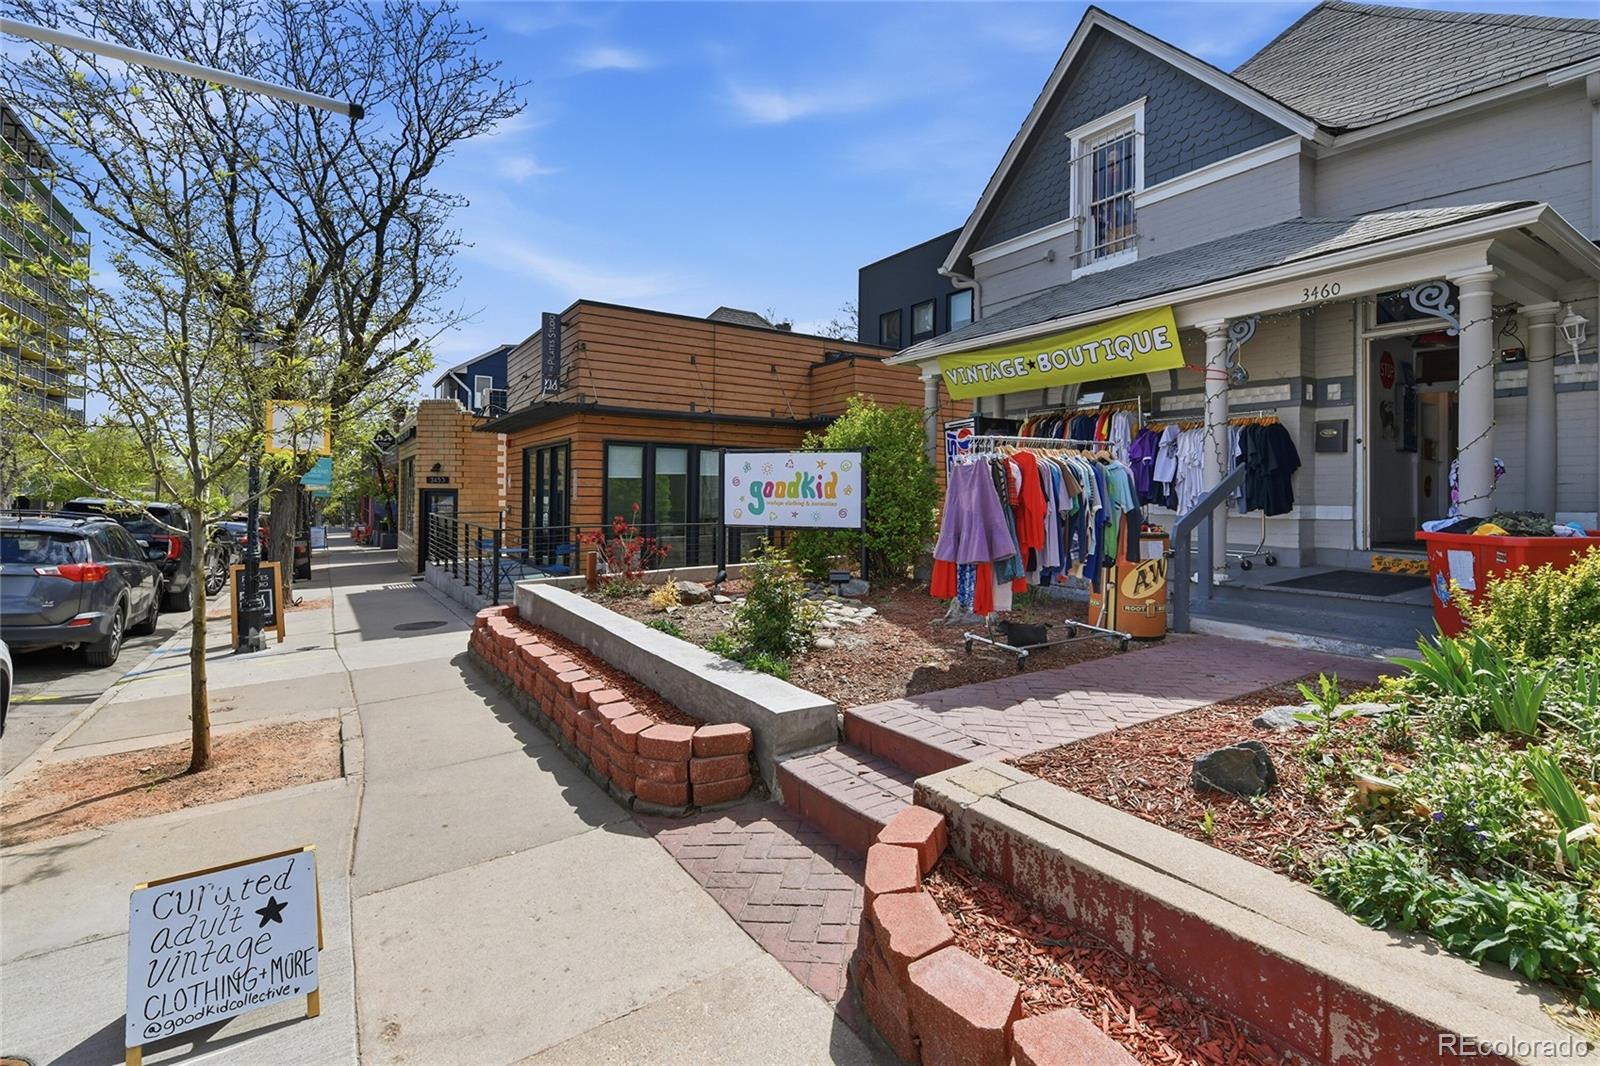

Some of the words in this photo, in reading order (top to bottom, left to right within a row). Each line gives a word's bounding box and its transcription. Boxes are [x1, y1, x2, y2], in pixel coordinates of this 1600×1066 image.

[1302, 283, 1341, 303] 3460
[945, 357, 1029, 386] VINTAGE
[1036, 325, 1173, 373] BOUTIQUE
[748, 471, 838, 516] goodkid
[150, 905, 244, 954] adult
[146, 932, 272, 989] vintage
[143, 984, 290, 1039] @goodkidcollective
